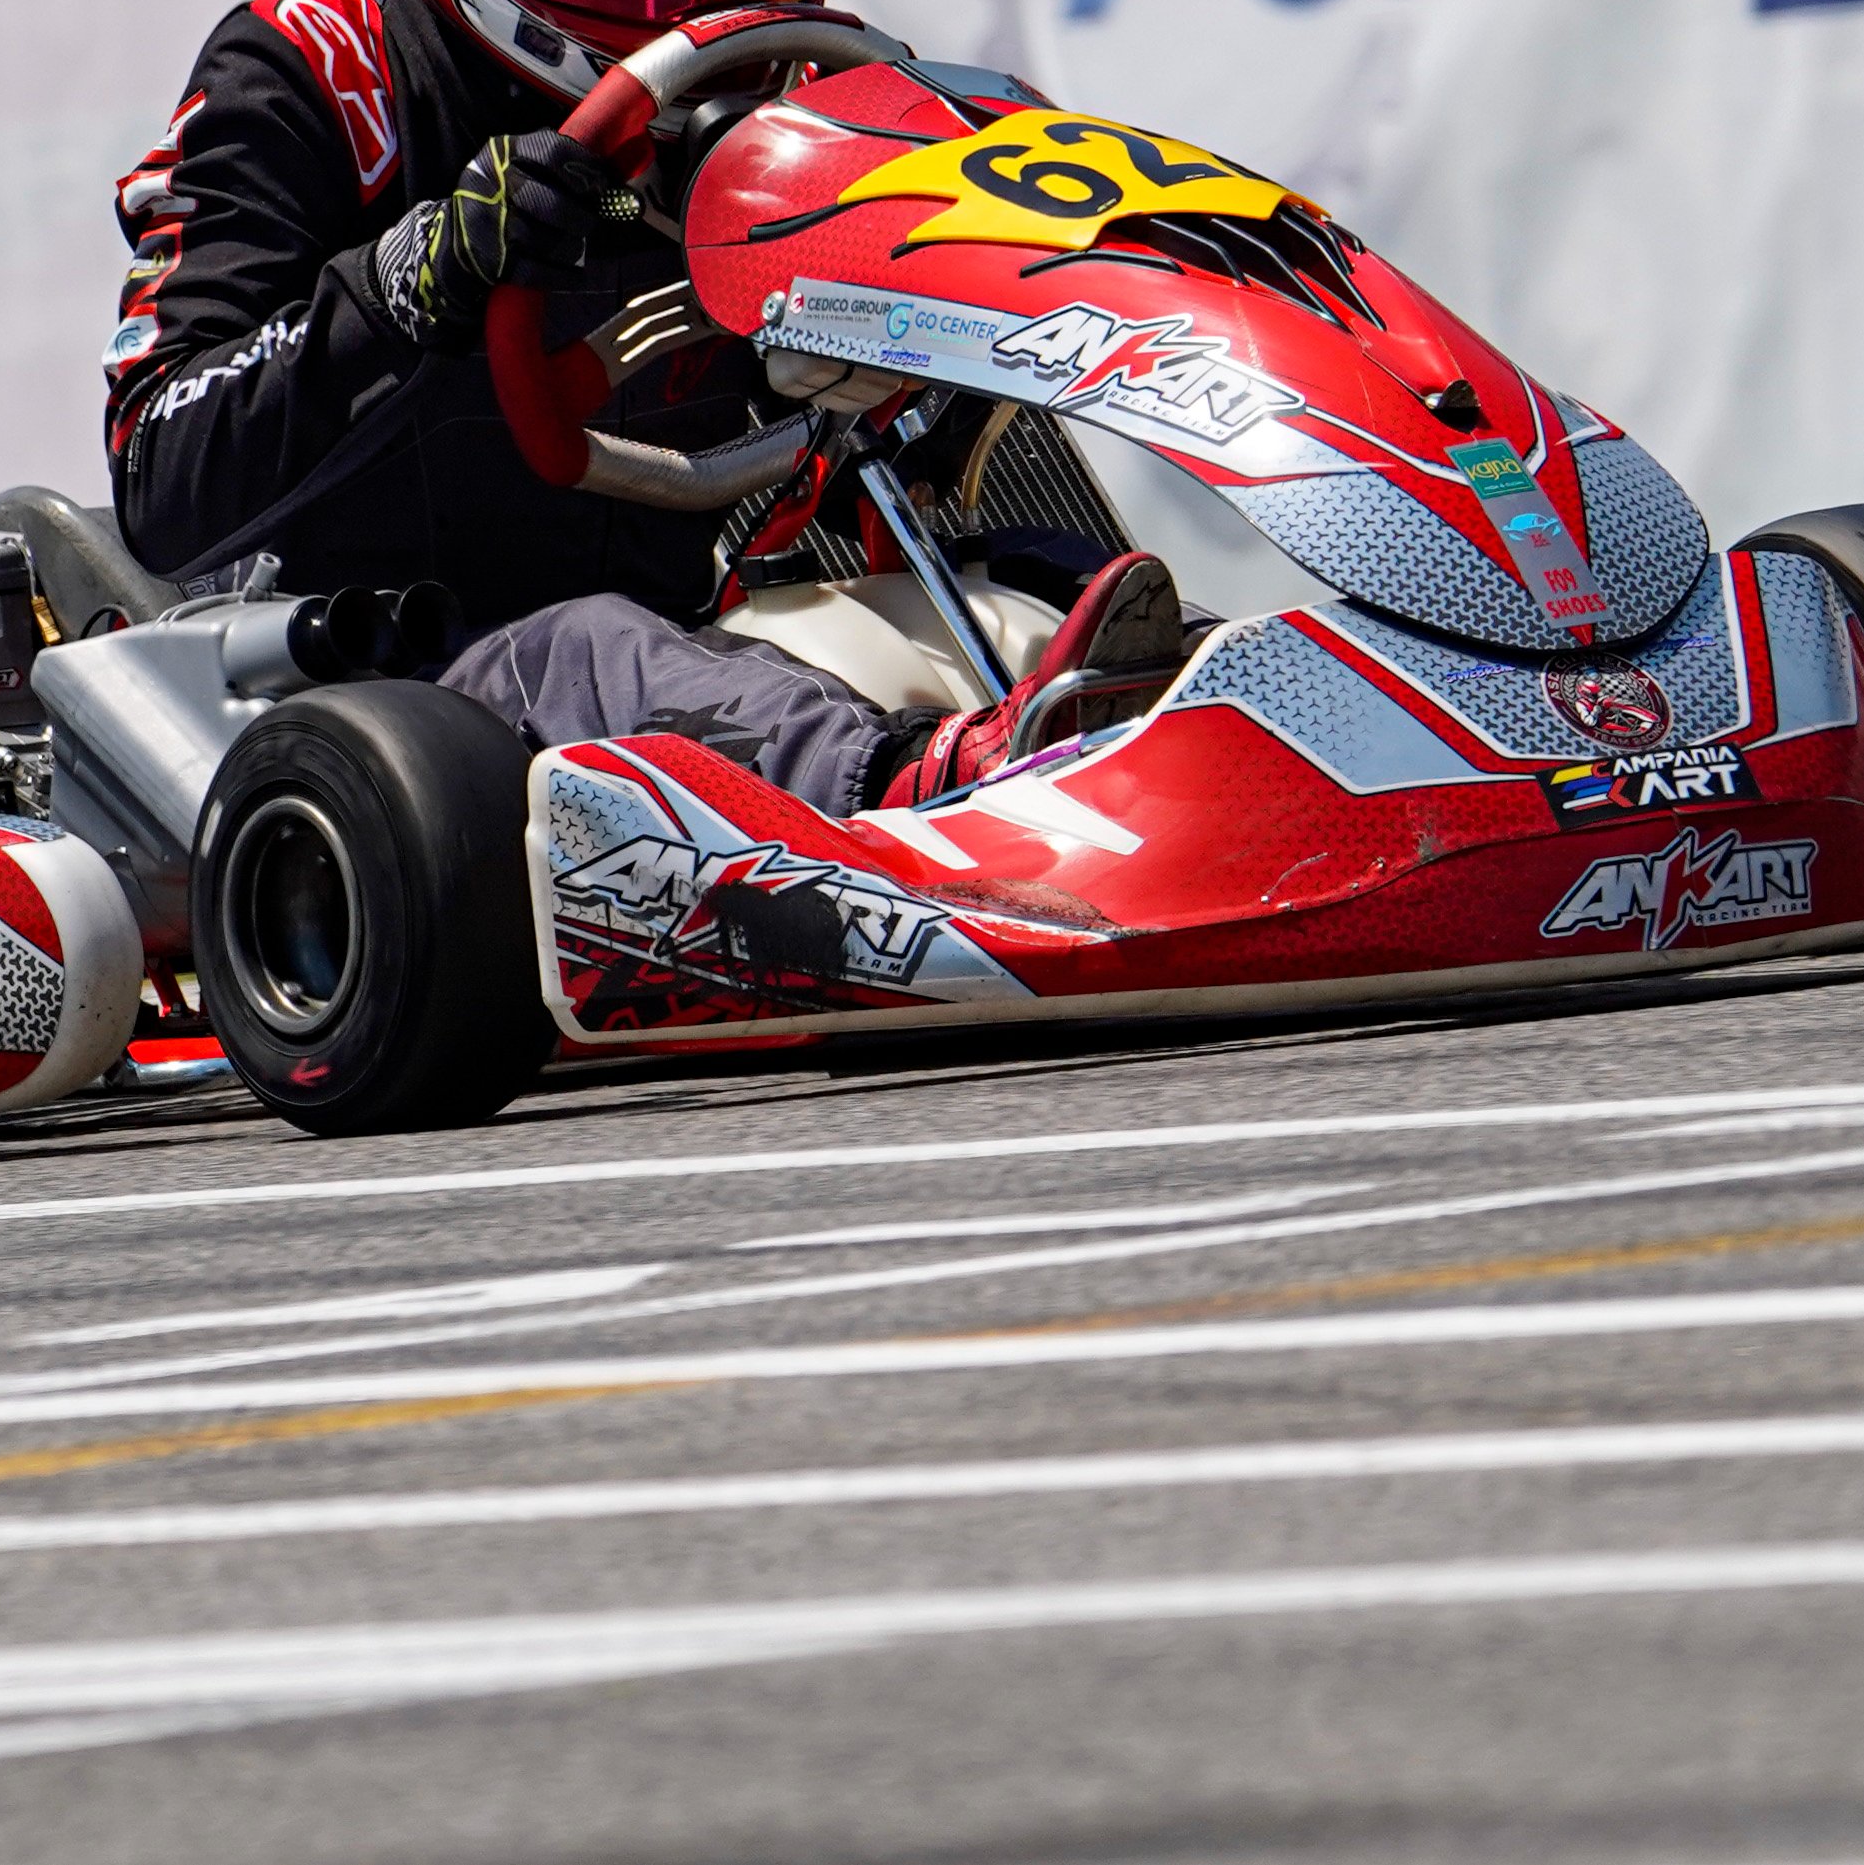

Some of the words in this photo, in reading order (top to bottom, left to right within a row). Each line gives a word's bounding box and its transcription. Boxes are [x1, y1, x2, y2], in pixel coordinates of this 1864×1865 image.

[807, 297, 849, 312] CEDICO
[850, 300, 891, 316] GROUP
[915, 311, 937, 330] GO
[940, 314, 999, 341] CENTER
[992, 303, 1302, 425] ANKART
[1108, 390, 1170, 418] RACING
[1545, 593, 1608, 620] SHOES
[1591, 744, 1738, 778] CAMPANIA
[1606, 763, 1741, 808] KART
[555, 835, 950, 958] ANKRT
[1542, 829, 1817, 950] ANKART
[1695, 906, 1761, 923] RACING
[846, 951, 904, 974] EAM
